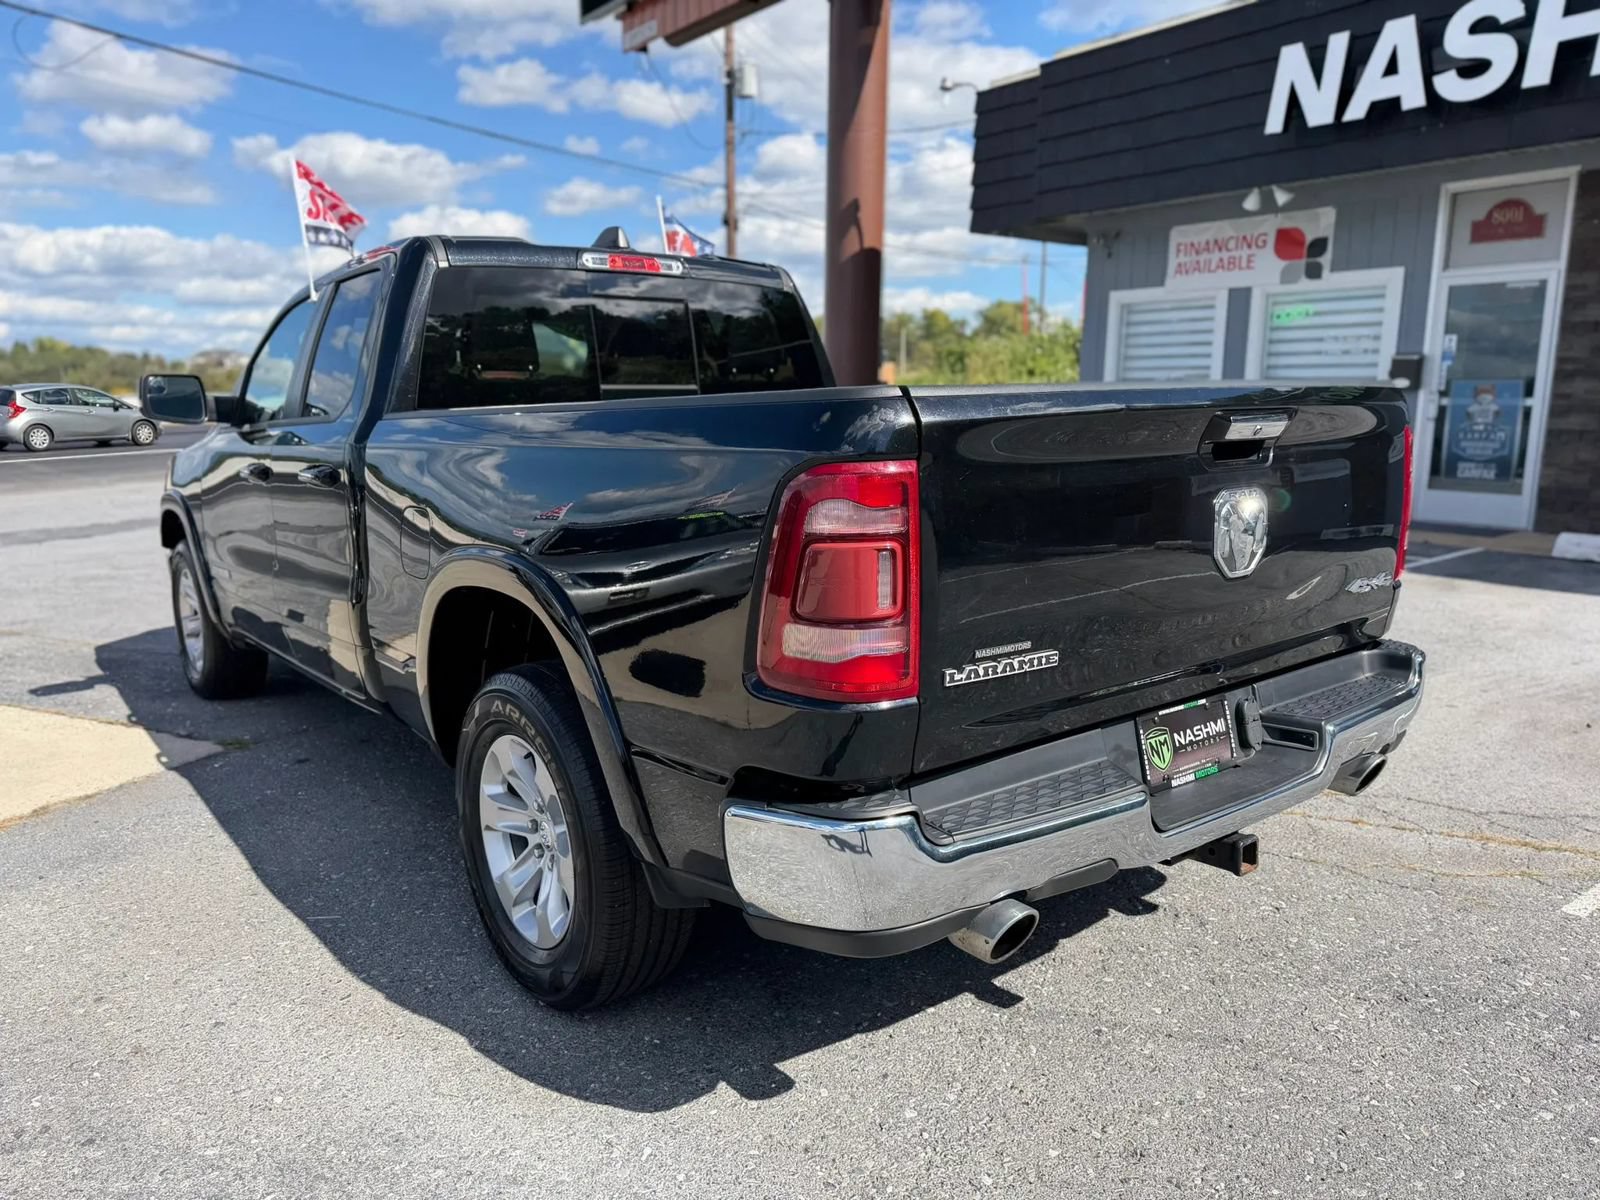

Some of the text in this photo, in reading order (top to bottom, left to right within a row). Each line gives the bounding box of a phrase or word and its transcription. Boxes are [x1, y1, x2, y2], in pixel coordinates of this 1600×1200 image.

[1175, 232, 1268, 258] FINANCING
[1174, 254, 1256, 277] AVAILABLE
[975, 640, 1032, 659] NASHMIMOTORS
[943, 650, 1059, 687] LARAMIE
[1173, 717, 1226, 747] NASHMI
[1186, 736, 1220, 752] MOTORS
[1148, 736, 1170, 764] NM
[1195, 765, 1219, 780] MOTORS
